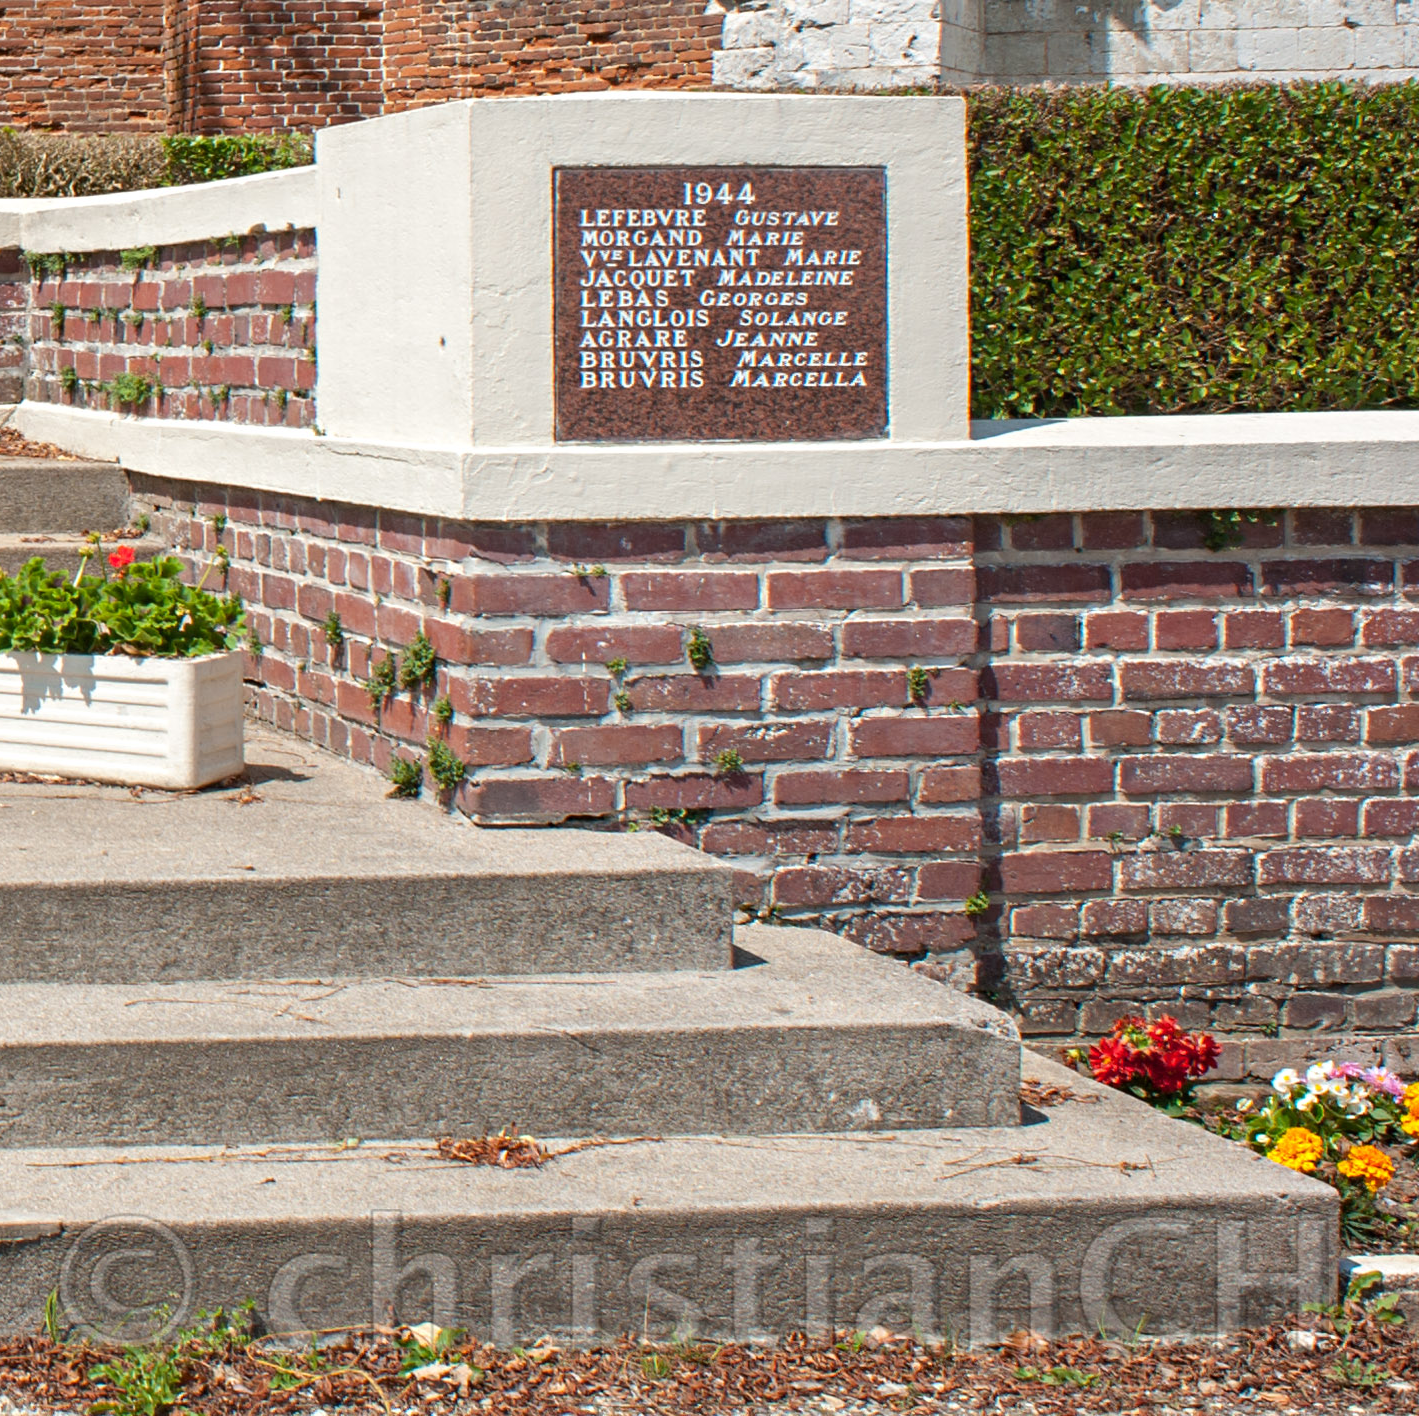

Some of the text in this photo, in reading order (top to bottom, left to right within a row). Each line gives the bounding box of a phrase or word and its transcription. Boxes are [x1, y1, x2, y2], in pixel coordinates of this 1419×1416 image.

[683, 181, 756, 206] 1944
[579, 209, 707, 228] LEFEBVRE
[580, 229, 703, 247] MORGAND
[628, 249, 760, 267] LAVENANT
[579, 269, 695, 290] JACQUET
[579, 289, 670, 308] LEBAS
[580, 309, 710, 328] LANGLOIS
[579, 330, 688, 349] AGRARE
[579, 350, 704, 369] BRUVRIS
[580, 369, 705, 389] BRUVRIS
